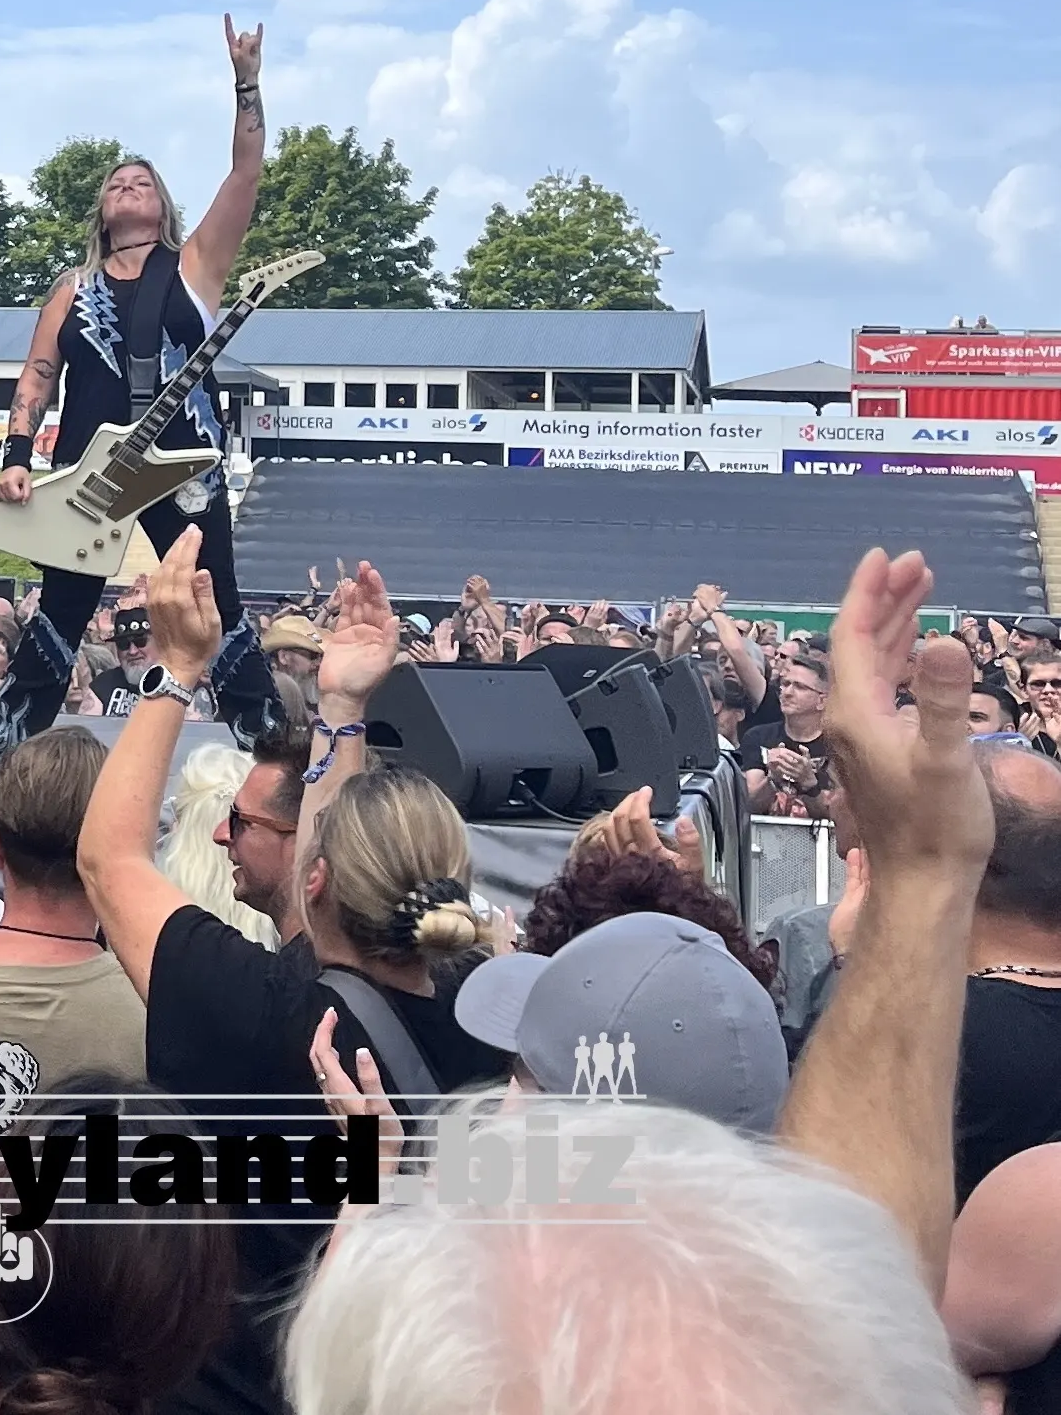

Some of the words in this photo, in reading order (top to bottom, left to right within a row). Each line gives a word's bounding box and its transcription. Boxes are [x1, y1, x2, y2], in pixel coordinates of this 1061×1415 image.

[273, 416, 333, 430] KYOCERA
[357, 417, 409, 429] AKI
[431, 416, 467, 430] alos
[522, 418, 590, 438] Making
[597, 420, 702, 437] information
[710, 422, 763, 438] faster
[817, 426, 884, 441] KYOCERA
[911, 429, 969, 442] AKI
[995, 428, 1035, 443] alos
[548, 449, 575, 460] AXA
[578, 449, 680, 461] Bezirksdirektion
[719, 462, 769, 471] PREMIUM
[882, 464, 923, 476] Energie
[925, 466, 949, 475] vom
[950, 466, 1014, 478] Niederrhein
